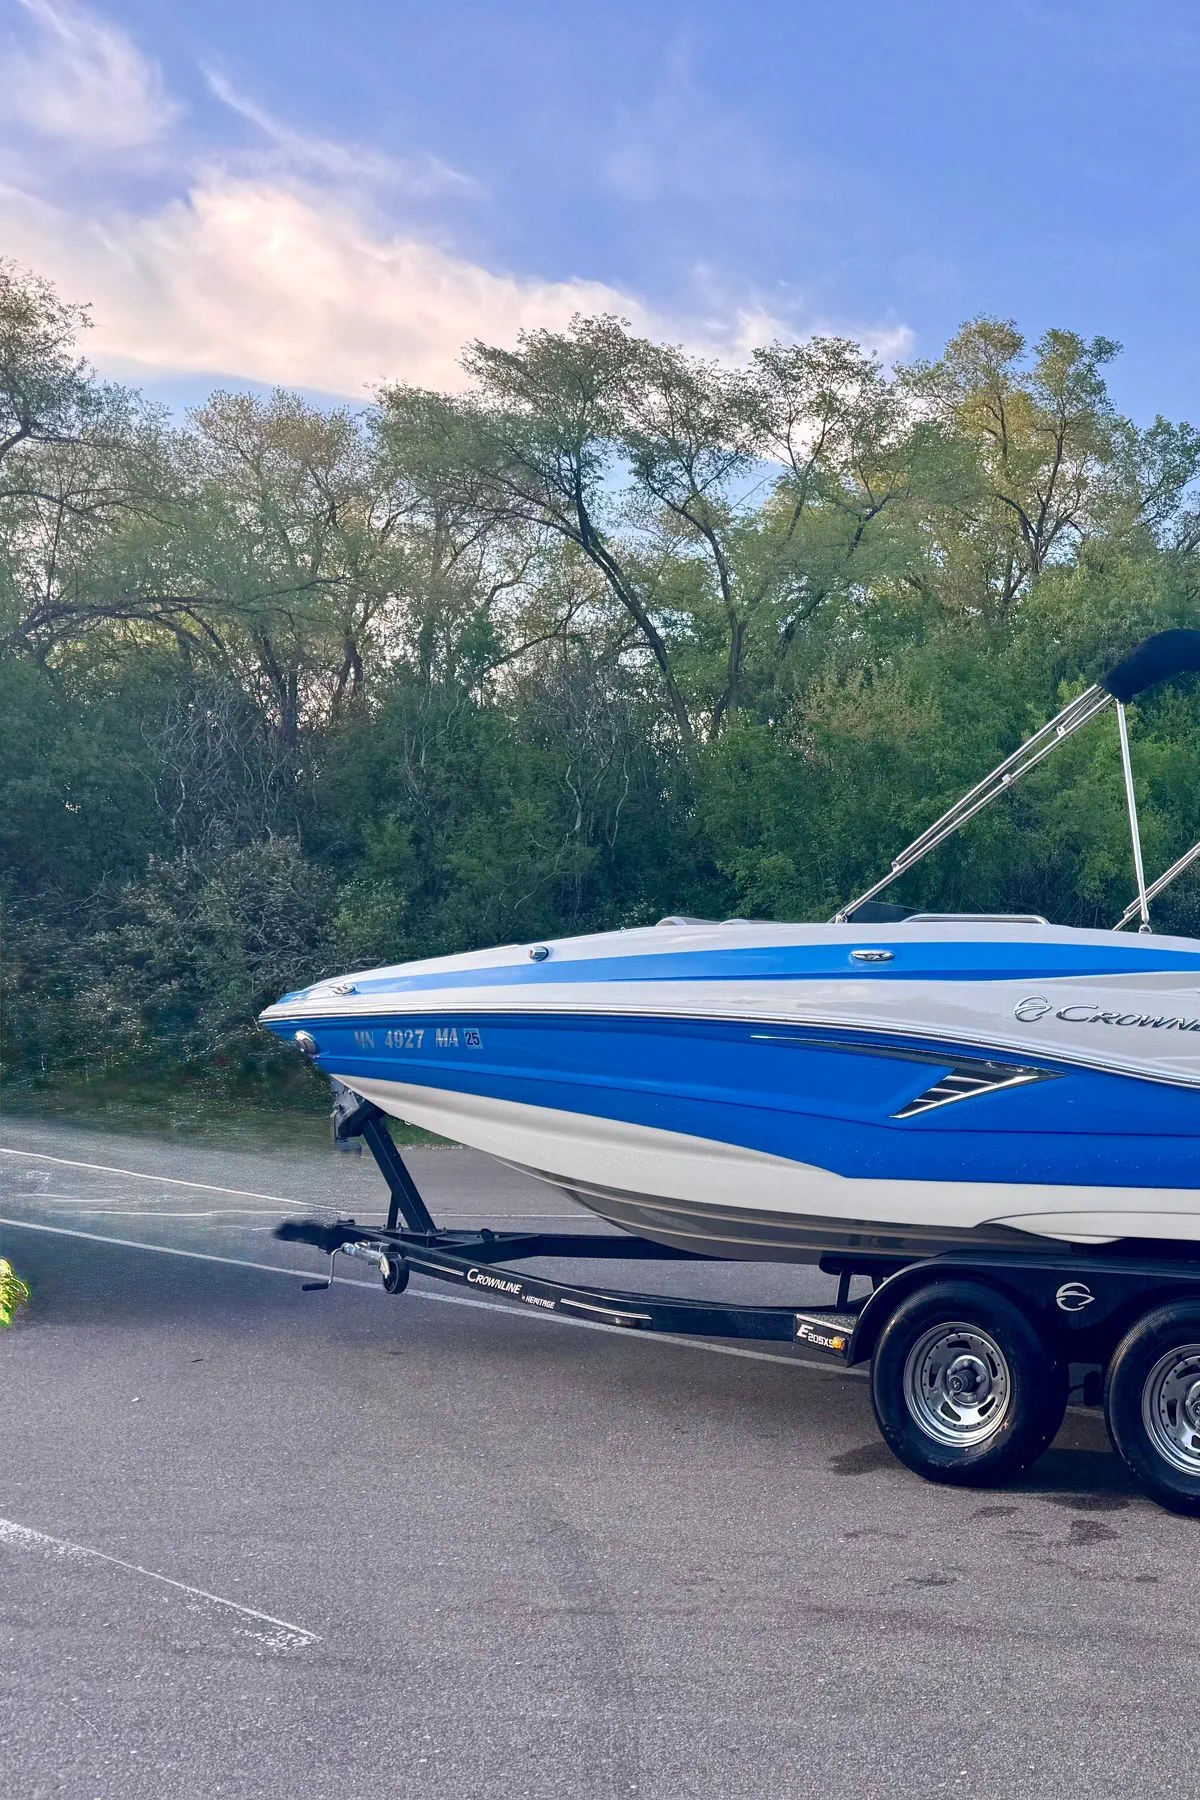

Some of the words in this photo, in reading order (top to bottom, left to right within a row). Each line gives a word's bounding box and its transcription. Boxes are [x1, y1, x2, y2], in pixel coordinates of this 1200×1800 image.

[384, 1029, 424, 1049] 4927
[435, 1028, 459, 1048] MA
[465, 1031, 480, 1047] 25
[467, 1268, 523, 1294] CROWNLINE
[525, 1295, 556, 1309] HERITAGE
